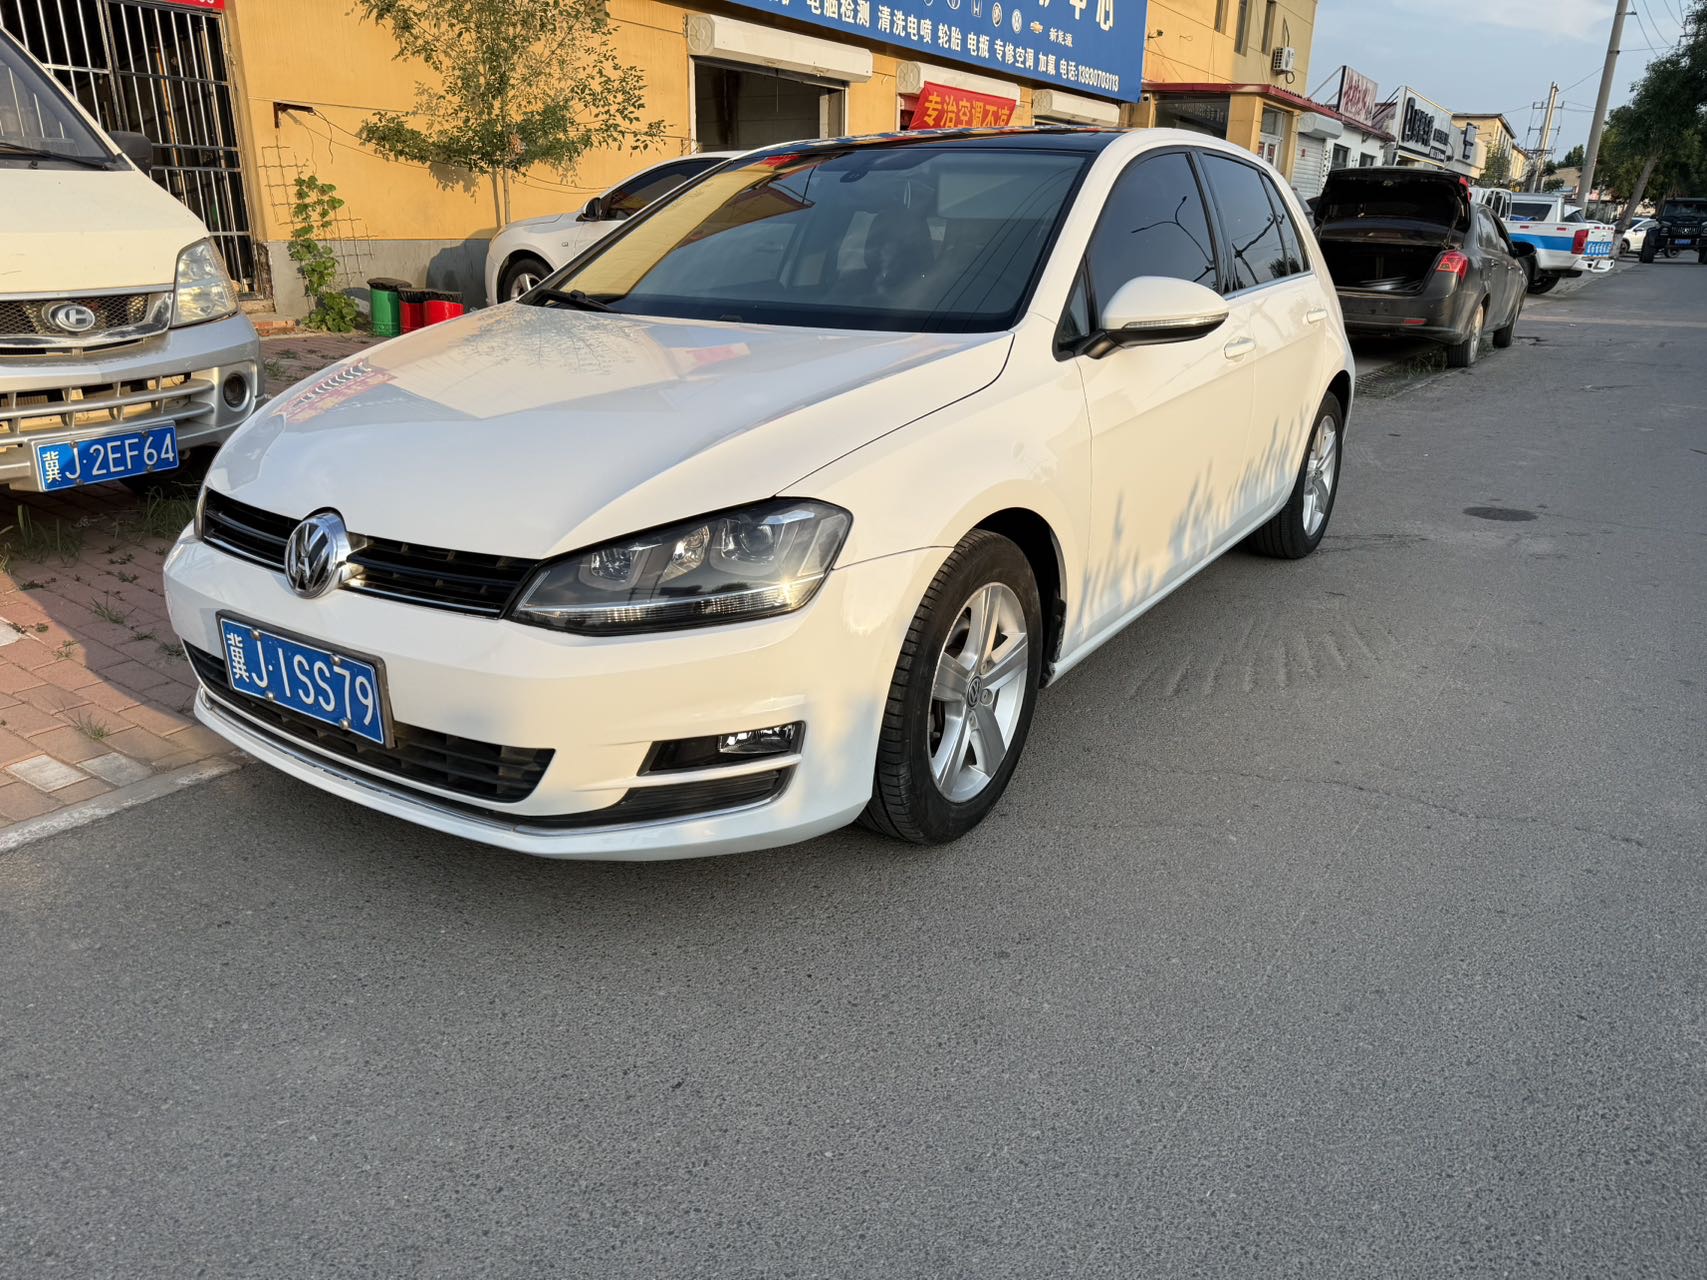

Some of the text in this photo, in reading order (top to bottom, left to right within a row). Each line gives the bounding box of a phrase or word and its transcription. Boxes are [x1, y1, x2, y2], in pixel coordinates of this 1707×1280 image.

[806, 0, 871, 27] 电脑检测
[878, 5, 932, 43] 清洗电喷
[938, 23, 961, 51] 轮胎
[967, 32, 989, 58] 电瓶
[994, 39, 1034, 70] 专修空调
[924, 92, 1010, 128] 专治空调不凉
